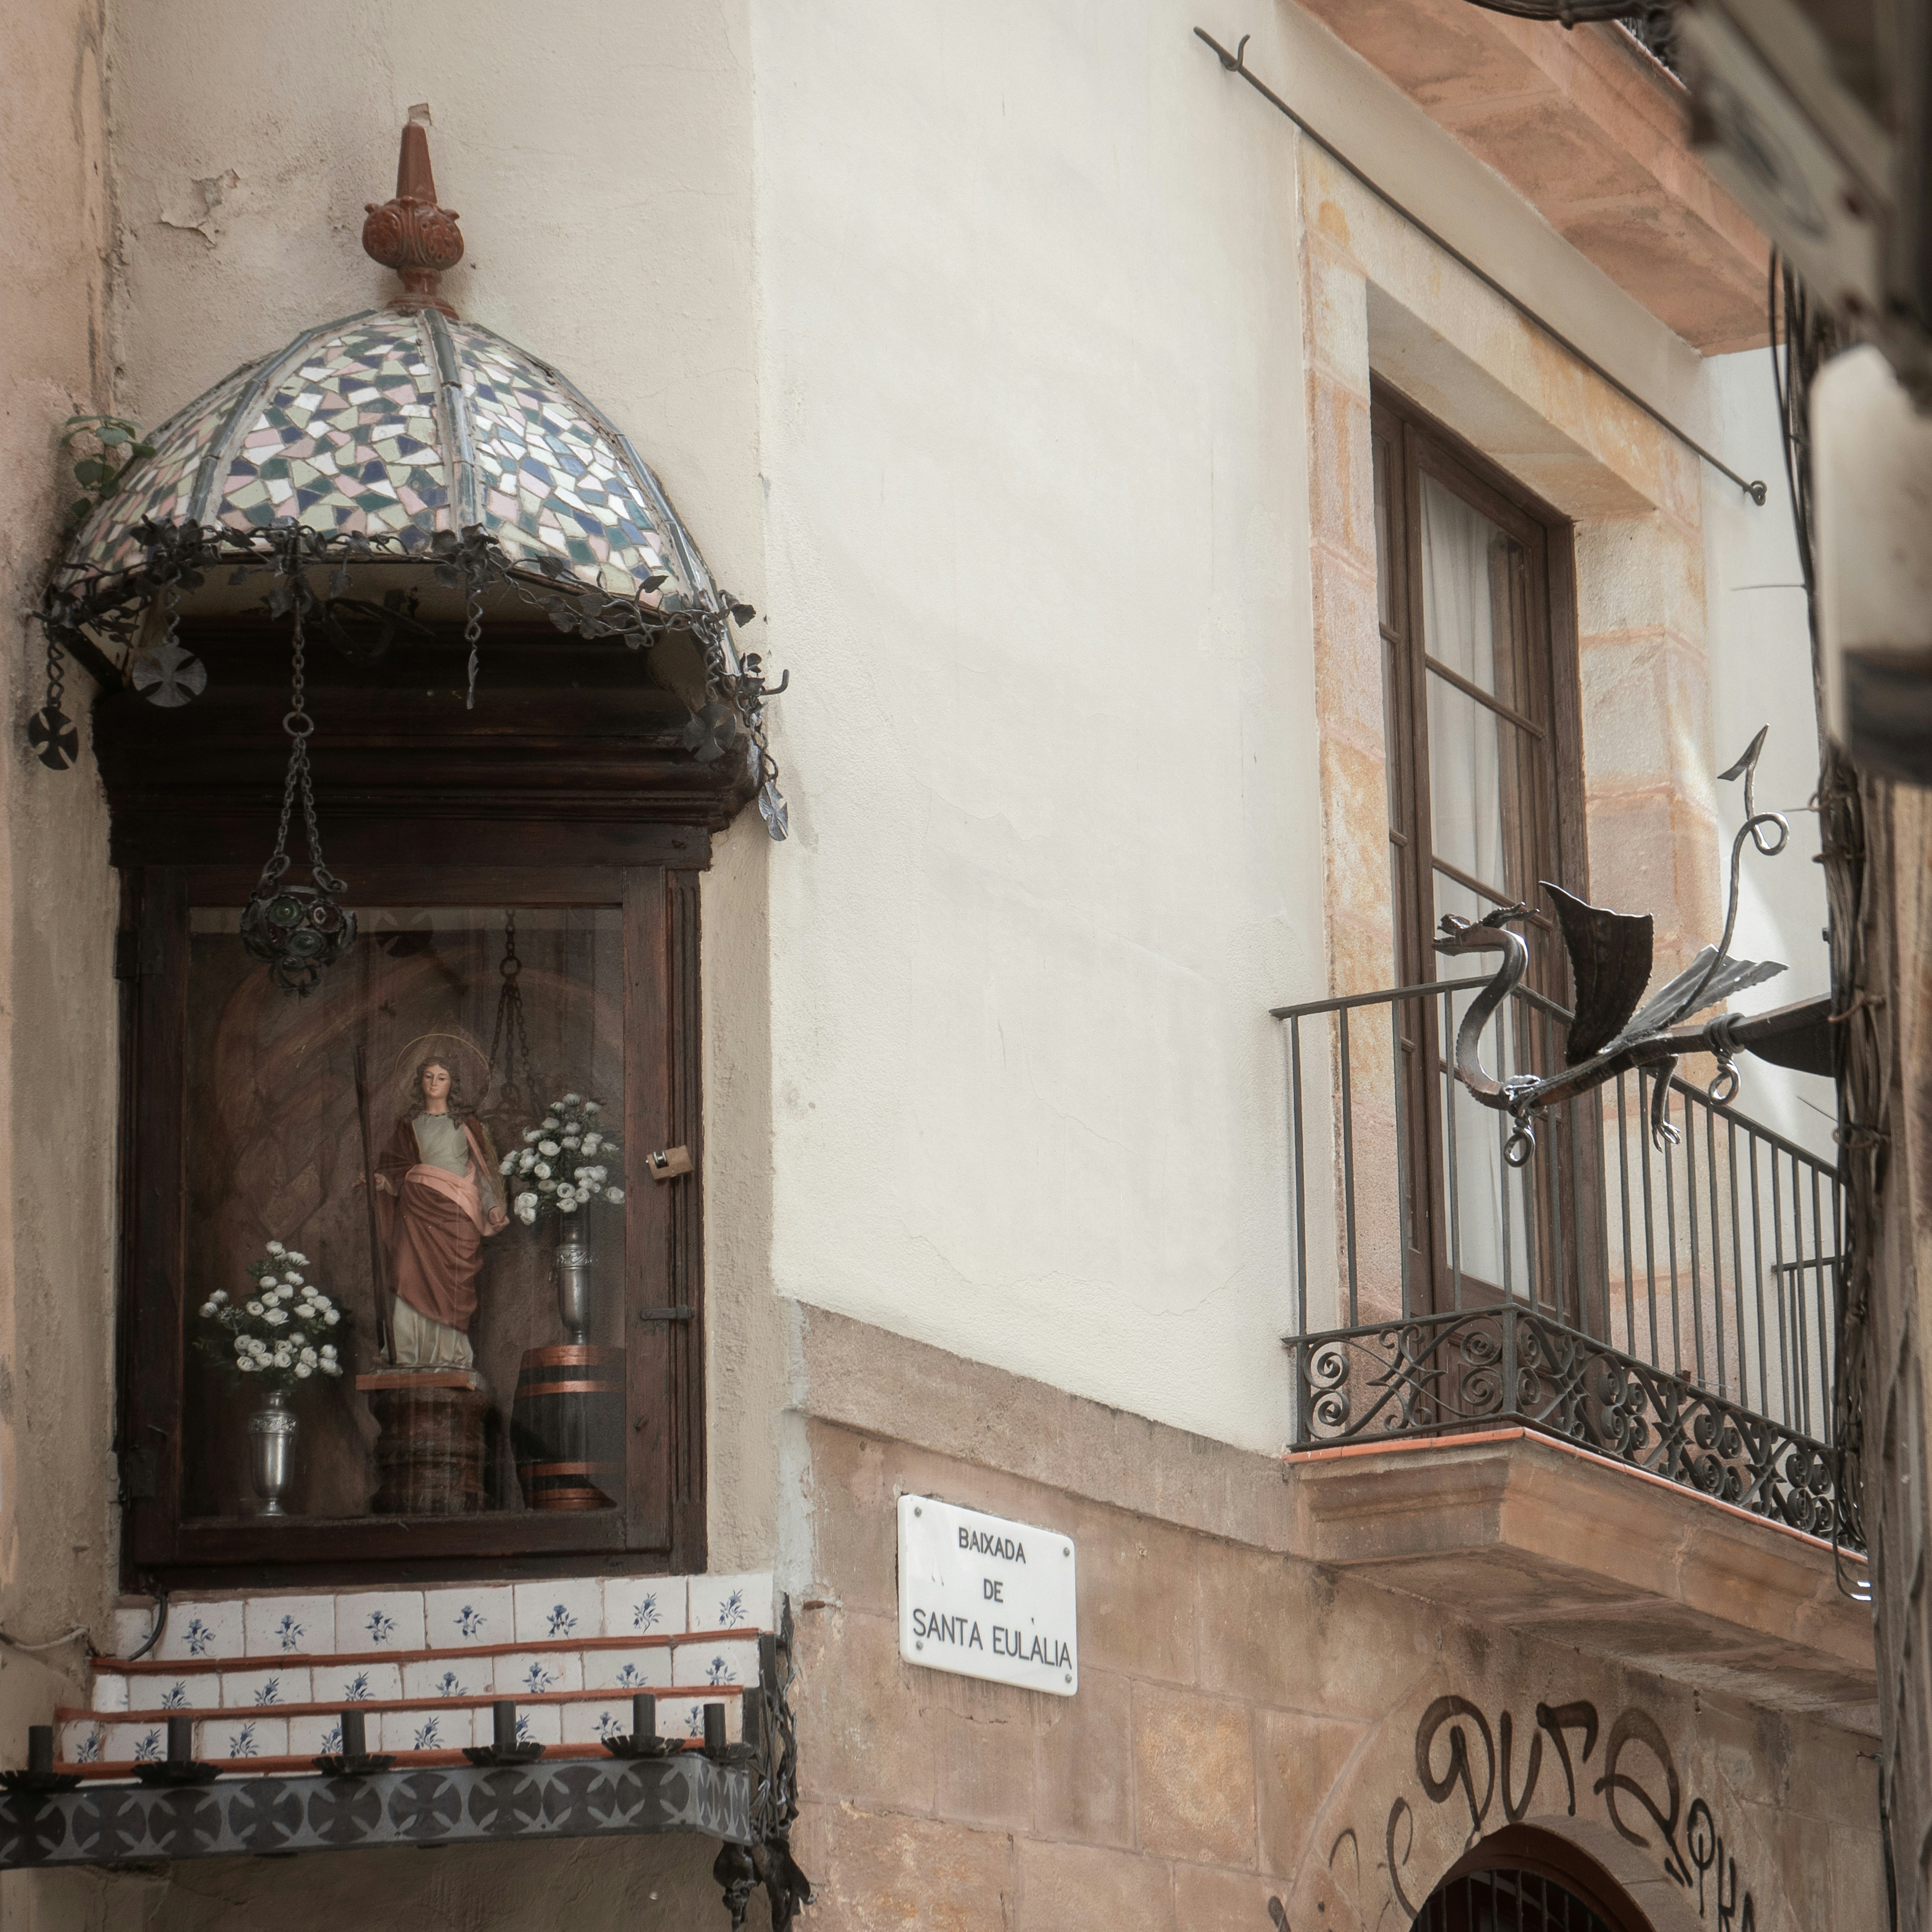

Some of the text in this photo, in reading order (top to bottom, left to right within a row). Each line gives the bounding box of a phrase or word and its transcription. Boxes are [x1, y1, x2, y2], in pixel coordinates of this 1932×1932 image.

[958, 1526, 1026, 1564] BAIXADA
[983, 1578, 1004, 1603] DE
[913, 1608, 983, 1650] SANTA
